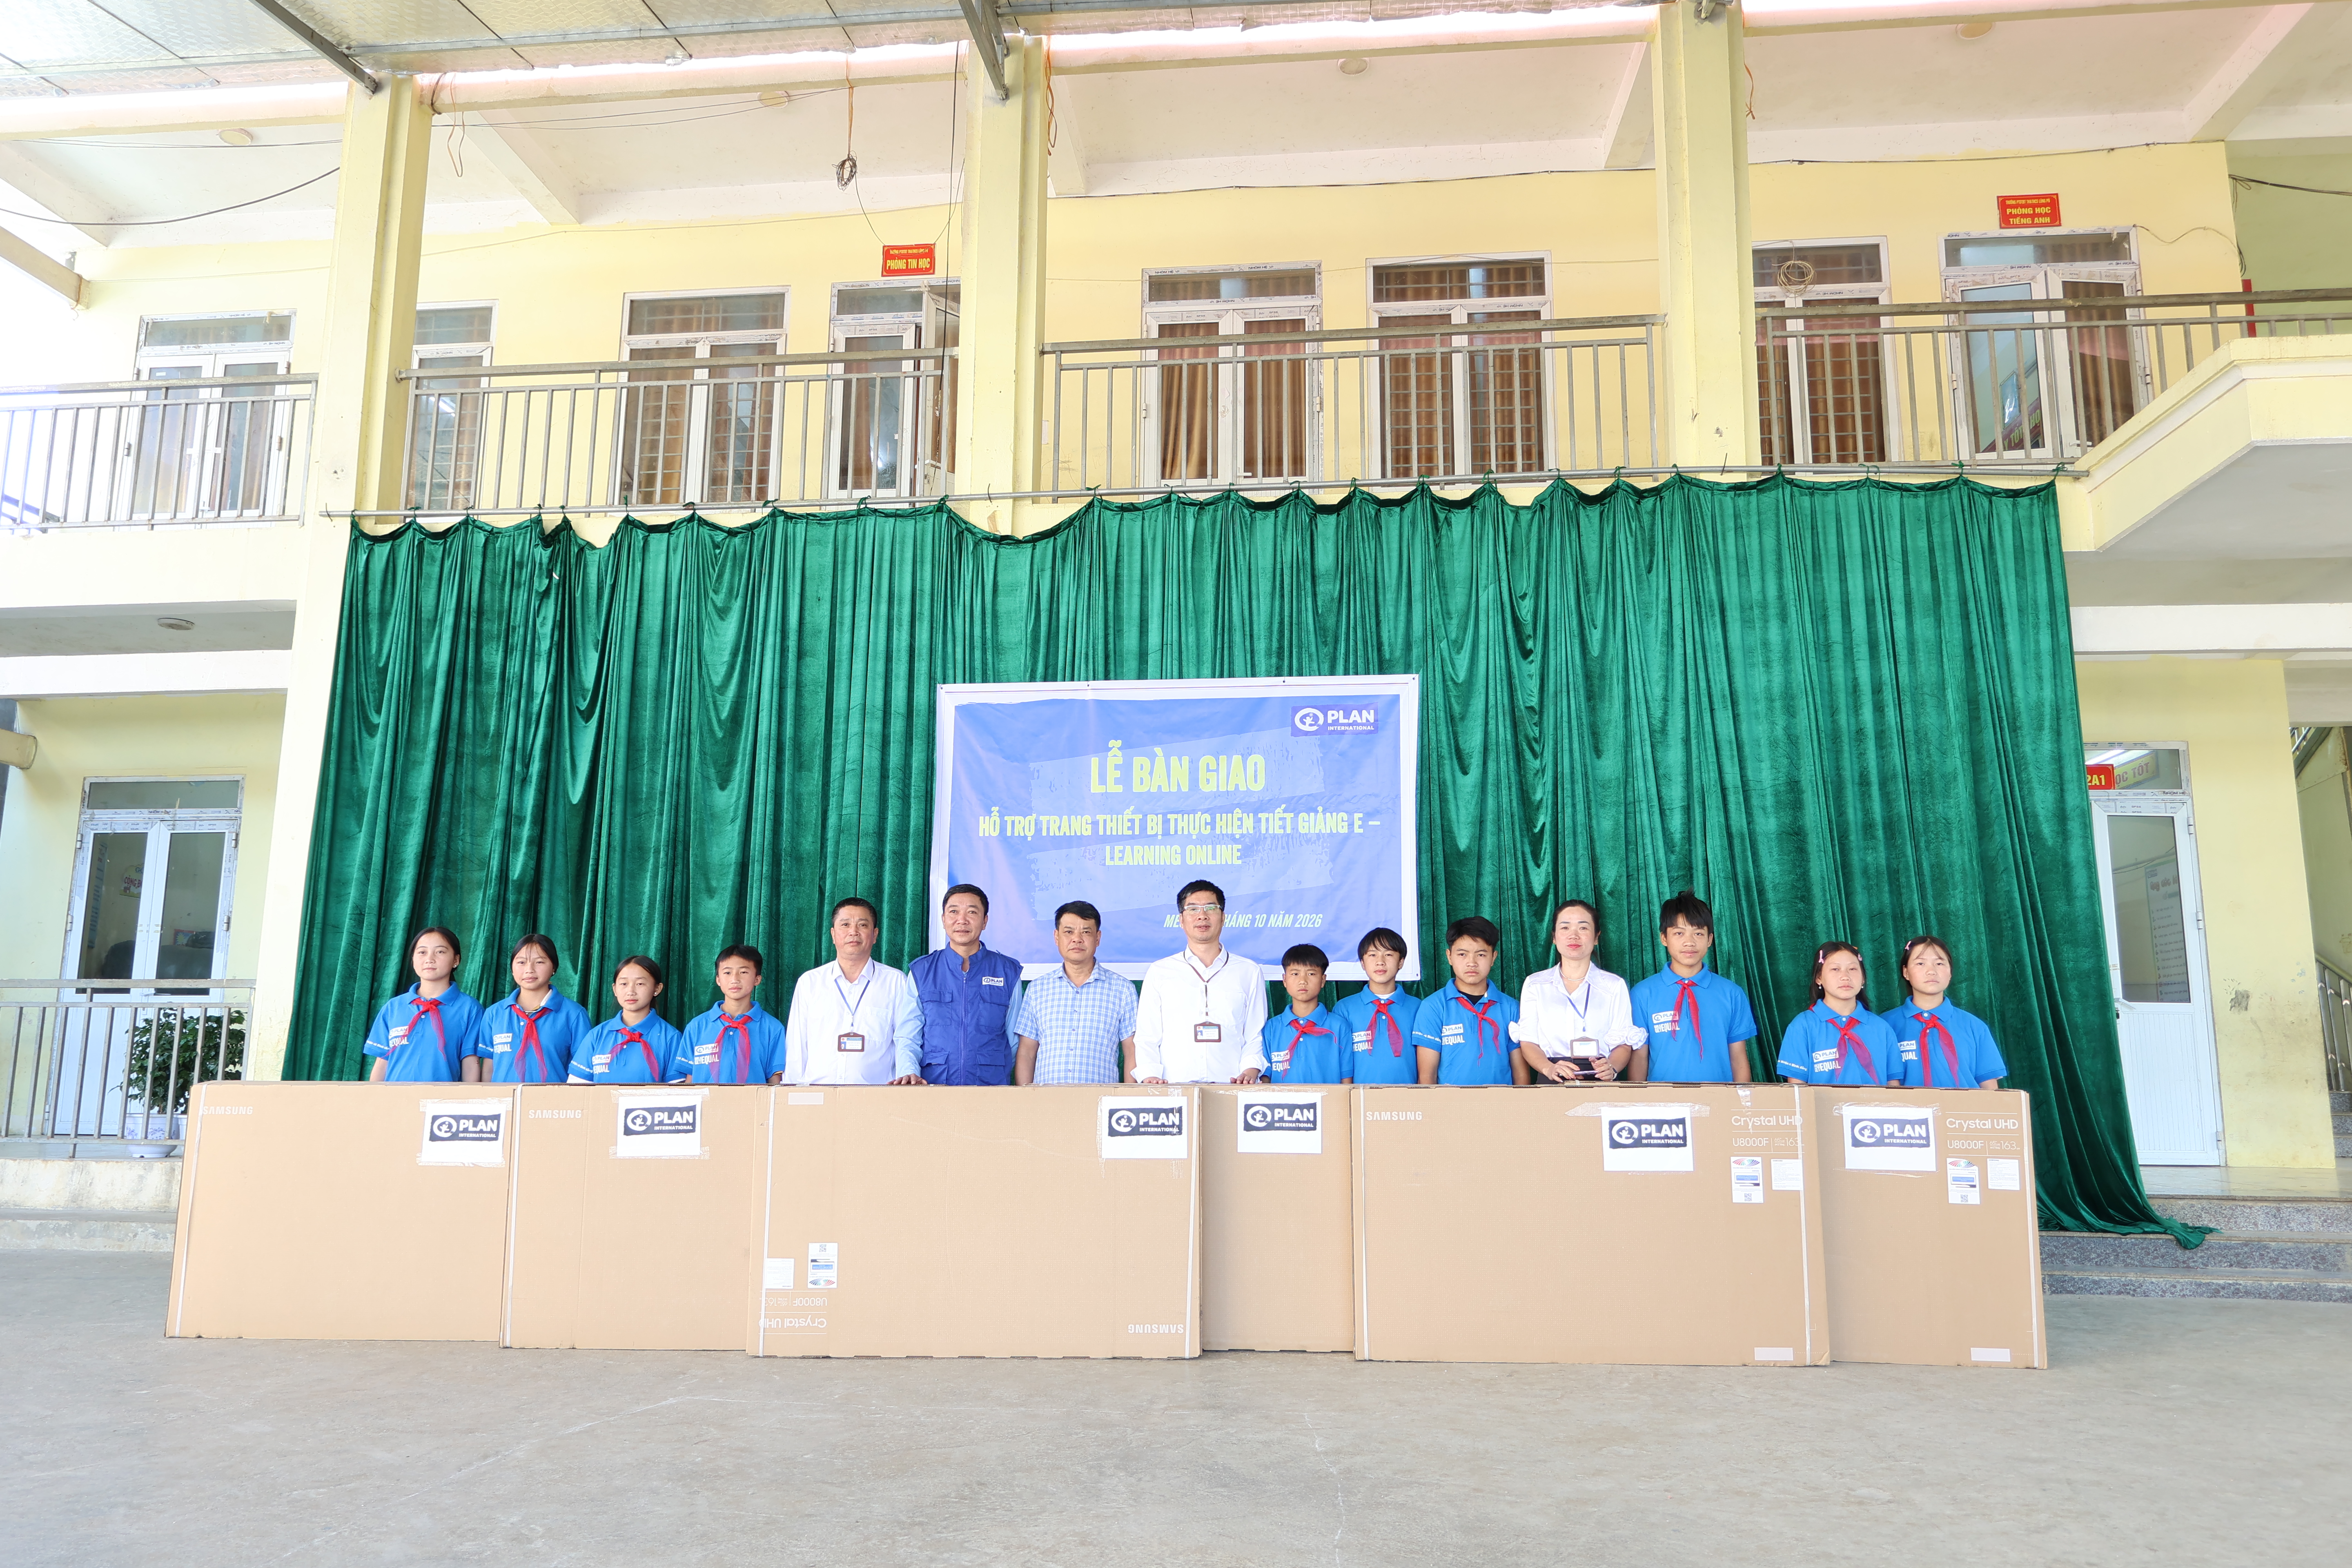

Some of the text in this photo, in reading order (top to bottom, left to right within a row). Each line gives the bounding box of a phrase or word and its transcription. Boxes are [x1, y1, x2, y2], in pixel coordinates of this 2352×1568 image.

[2007, 207, 2051, 215] PHÒNG HỌC
[2009, 216, 2031, 224] TIẾNG
[886, 257, 930, 270] PHÒNG TIN HỌC
[2030, 409, 2041, 429] HỌ
[1327, 710, 1374, 723] PLAN
[1091, 739, 1265, 793] LỄ BÀN GIAO
[2115, 760, 2150, 787] ỌC TỐT
[979, 806, 1000, 836] HỖ
[1004, 813, 1036, 841] TRỢ
[1040, 815, 1091, 836] TRANG
[1096, 806, 1143, 835] THIẾT
[1147, 814, 1163, 840] BỊ
[1167, 811, 1211, 839] THỰC
[1216, 808, 1254, 839] HIỆN
[1258, 804, 1294, 834] TIẾT
[1298, 806, 1348, 833] GIẢNG
[1354, 813, 1363, 833] E
[1105, 844, 1242, 865] LEARNING ONLINE
[1163, 911, 1323, 927] ME HÁNG 10 NĂM 2026
[1662, 1022, 1680, 1032] EQUAL
[1445, 1035, 1465, 1045] EQUAL
[1354, 1042, 1373, 1052] EQUAL
[701, 1054, 719, 1065] EQUAL
[1901, 1051, 1918, 1062] QUAL
[1273, 1061, 1290, 1072] EQUAL
[1820, 1060, 1841, 1072] EQUAL
[203, 1106, 254, 1115] SAMSUNG
[528, 1109, 581, 1119] SAMSUNG
[1274, 1108, 1314, 1121] PLAN
[1366, 1111, 1422, 1120] SAMSUNG
[654, 1111, 693, 1124] PLAN
[1139, 1113, 1179, 1125] PLAN
[1731, 1115, 1776, 1129] Crystal
[459, 1119, 498, 1131] PLAN
[1883, 1124, 1926, 1137] PLAN
[1946, 1118, 2018, 1131] Crystal UHD
[1641, 1125, 1683, 1137] PLAN
[1733, 1138, 1769, 1146] U8000F
[1947, 1140, 1984, 1149] U8000F
[2000, 1141, 2016, 1149] 163
[793, 1297, 827, 1306] U8000F
[784, 1315, 827, 1328] Crystal
[1128, 1324, 1184, 1334] SAMSUNG
